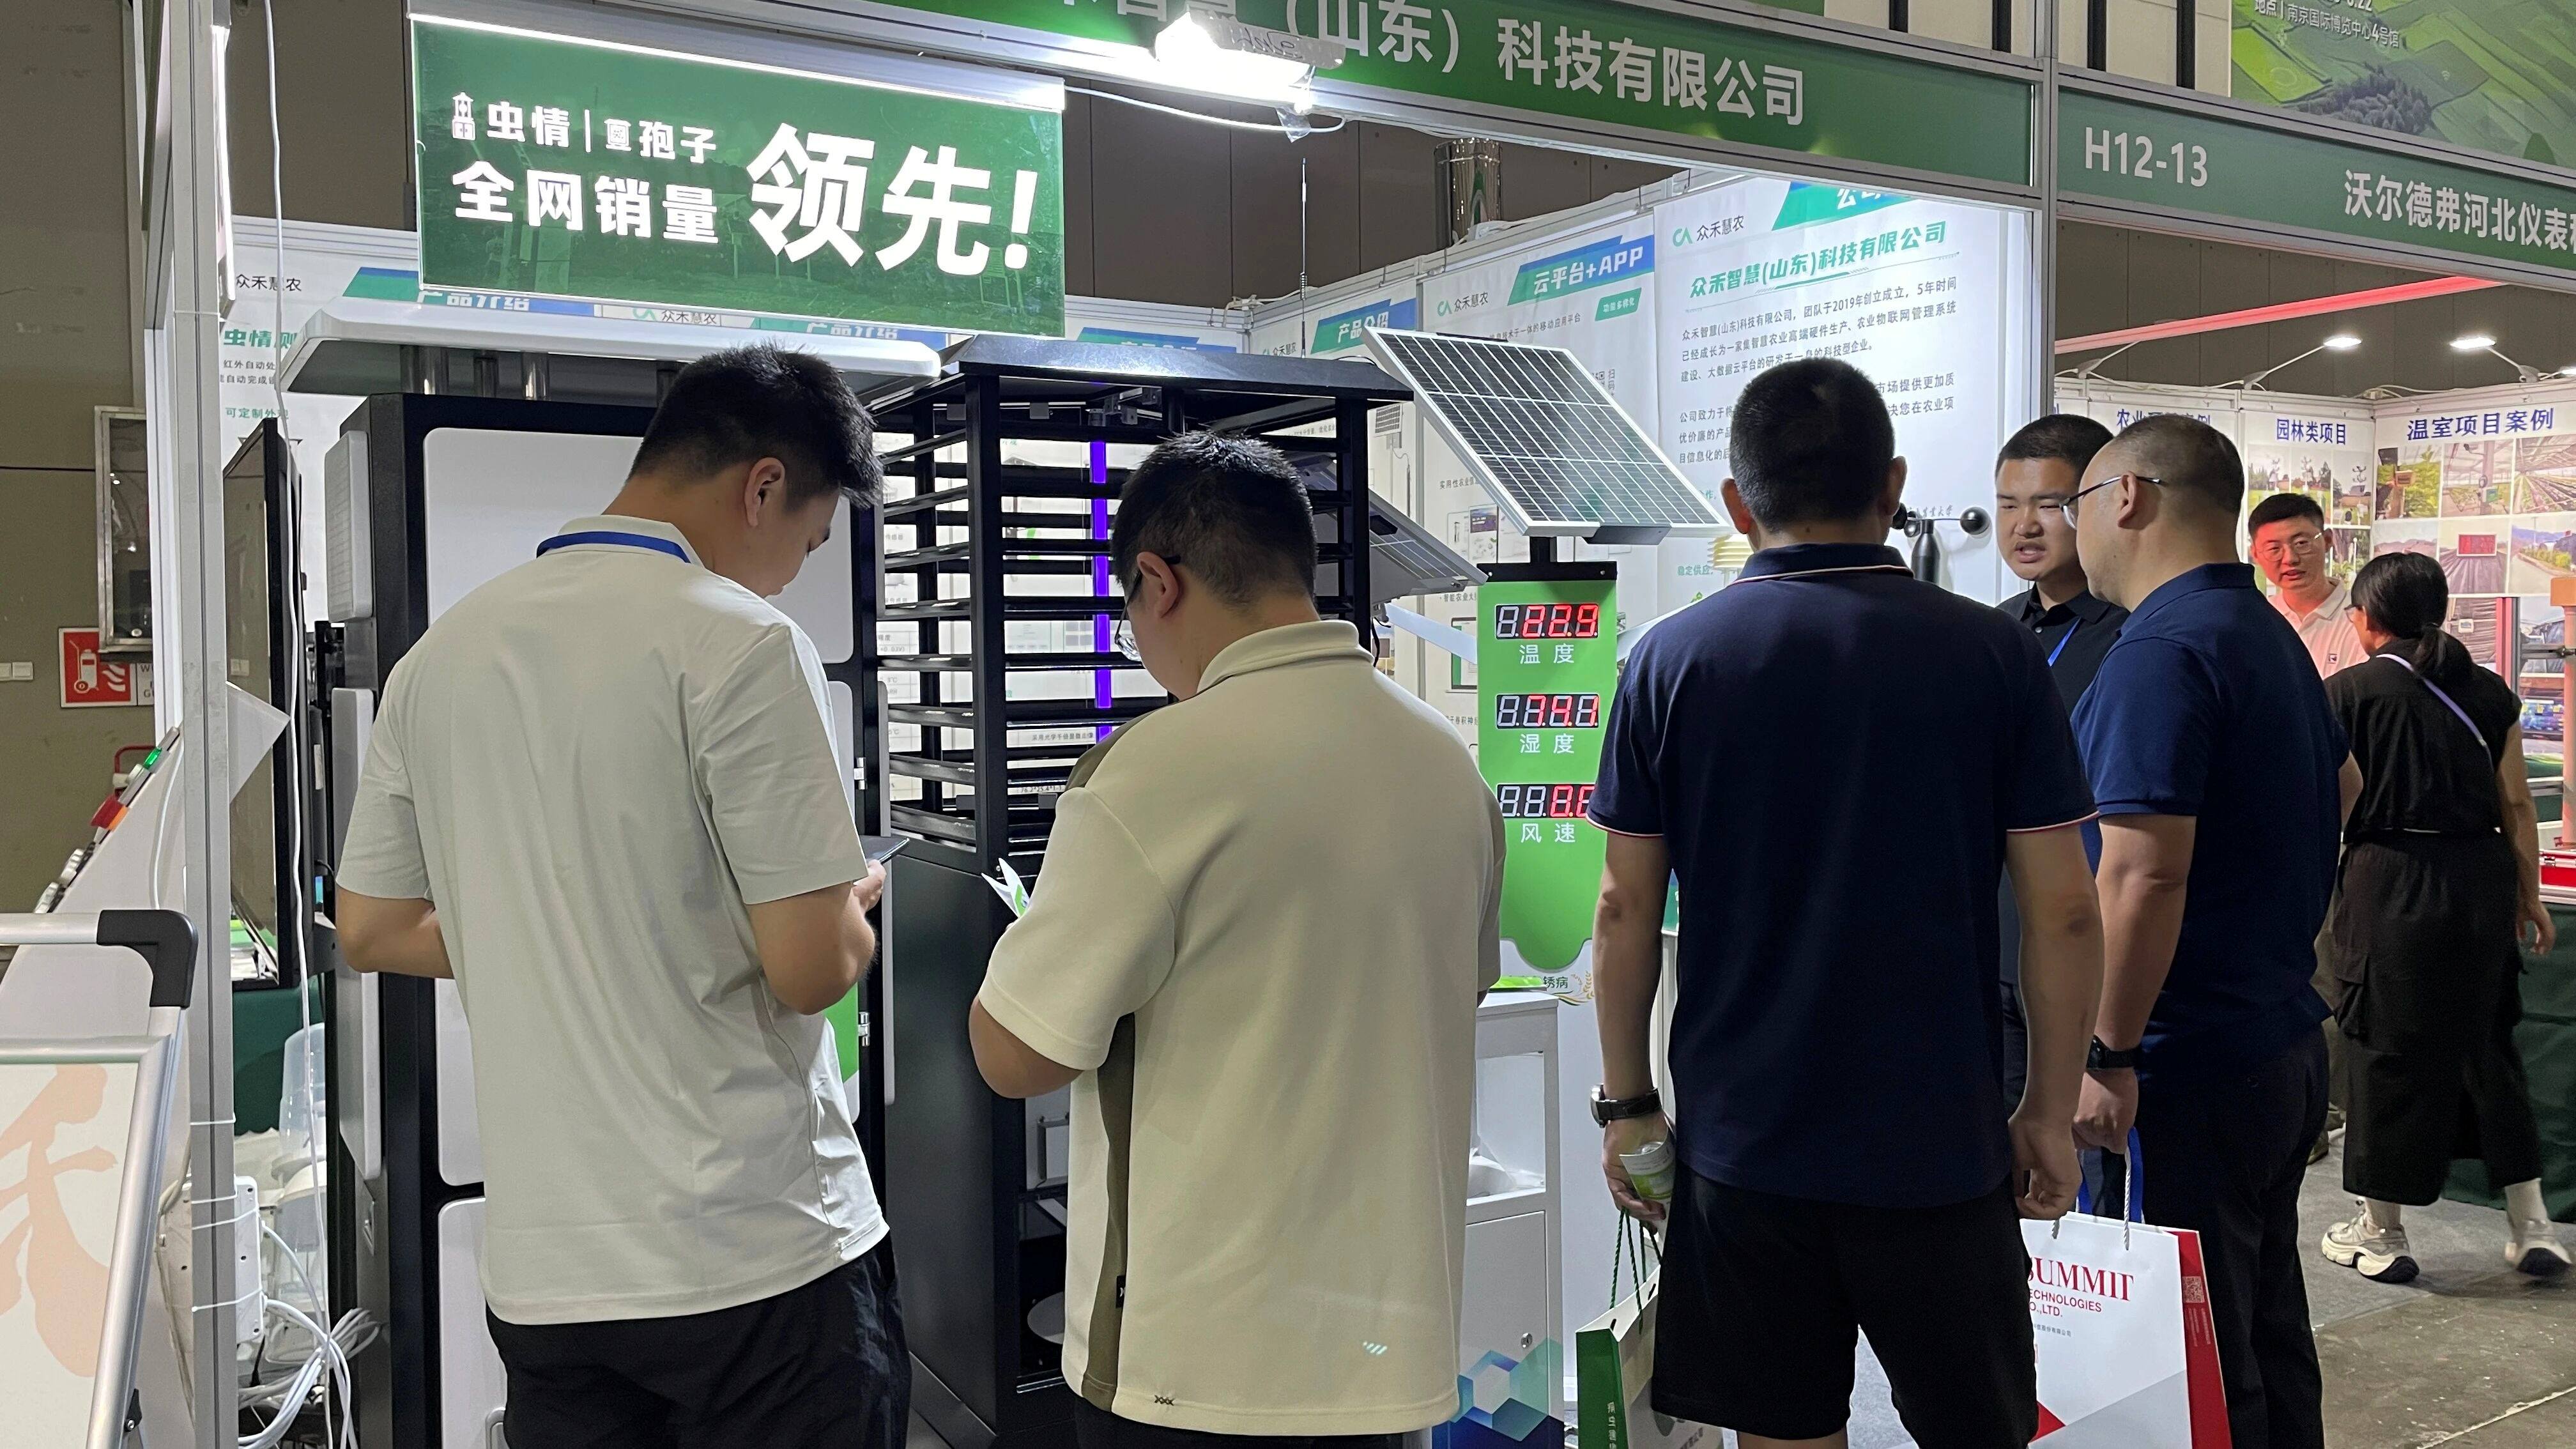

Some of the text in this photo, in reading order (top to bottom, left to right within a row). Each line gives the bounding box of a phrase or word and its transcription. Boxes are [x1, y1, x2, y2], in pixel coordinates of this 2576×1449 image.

[1117, 0, 1804, 126] （山东）科技有限公司
[487, 100, 717, 164] 虫情 孢子
[2085, 126, 2208, 187] H12-13
[451, 121, 1039, 277] 全网销量 领先!
[1696, 215, 1745, 242] 众禾慧农
[1533, 245, 1644, 296] 云平台+APP
[1690, 220, 1947, 298] 众禾智慧(山东)科技有限公司
[1453, 291, 1489, 313] 众禾慧农
[2276, 418, 2347, 445] 园林类项目
[2407, 408, 2555, 442] 温室项目案例
[1519, 643, 1575, 664] 温度
[1519, 733, 1575, 754] 湿度
[1521, 822, 1576, 843] 风速
[2028, 1301, 2063, 1317] O.,LTD.
[2029, 1288, 2102, 1313] ECHNOLOGIES
